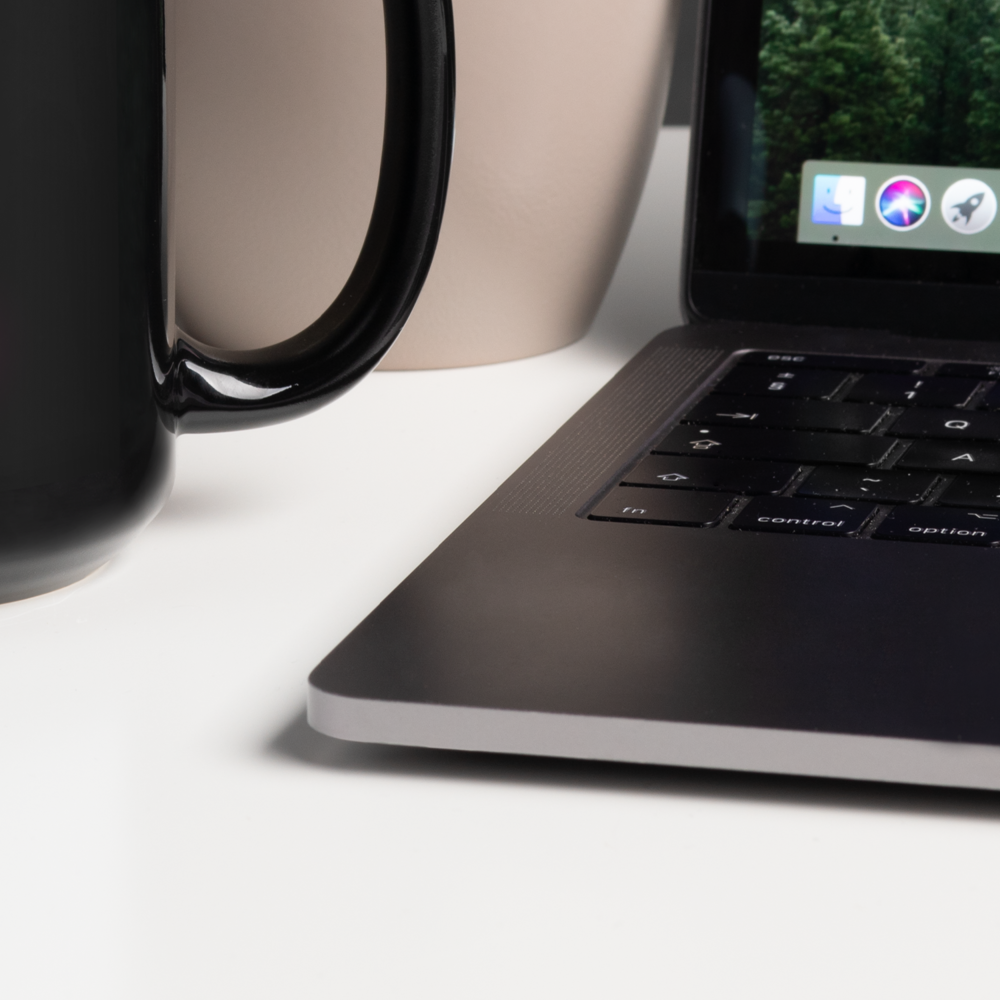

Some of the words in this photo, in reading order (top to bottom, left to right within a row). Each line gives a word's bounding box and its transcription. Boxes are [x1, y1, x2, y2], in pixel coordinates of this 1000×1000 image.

[944, 420, 970, 430] Q
[951, 453, 975, 462] A
[622, 506, 647, 514] fn
[757, 516, 845, 527] control
[908, 525, 987, 538] option
